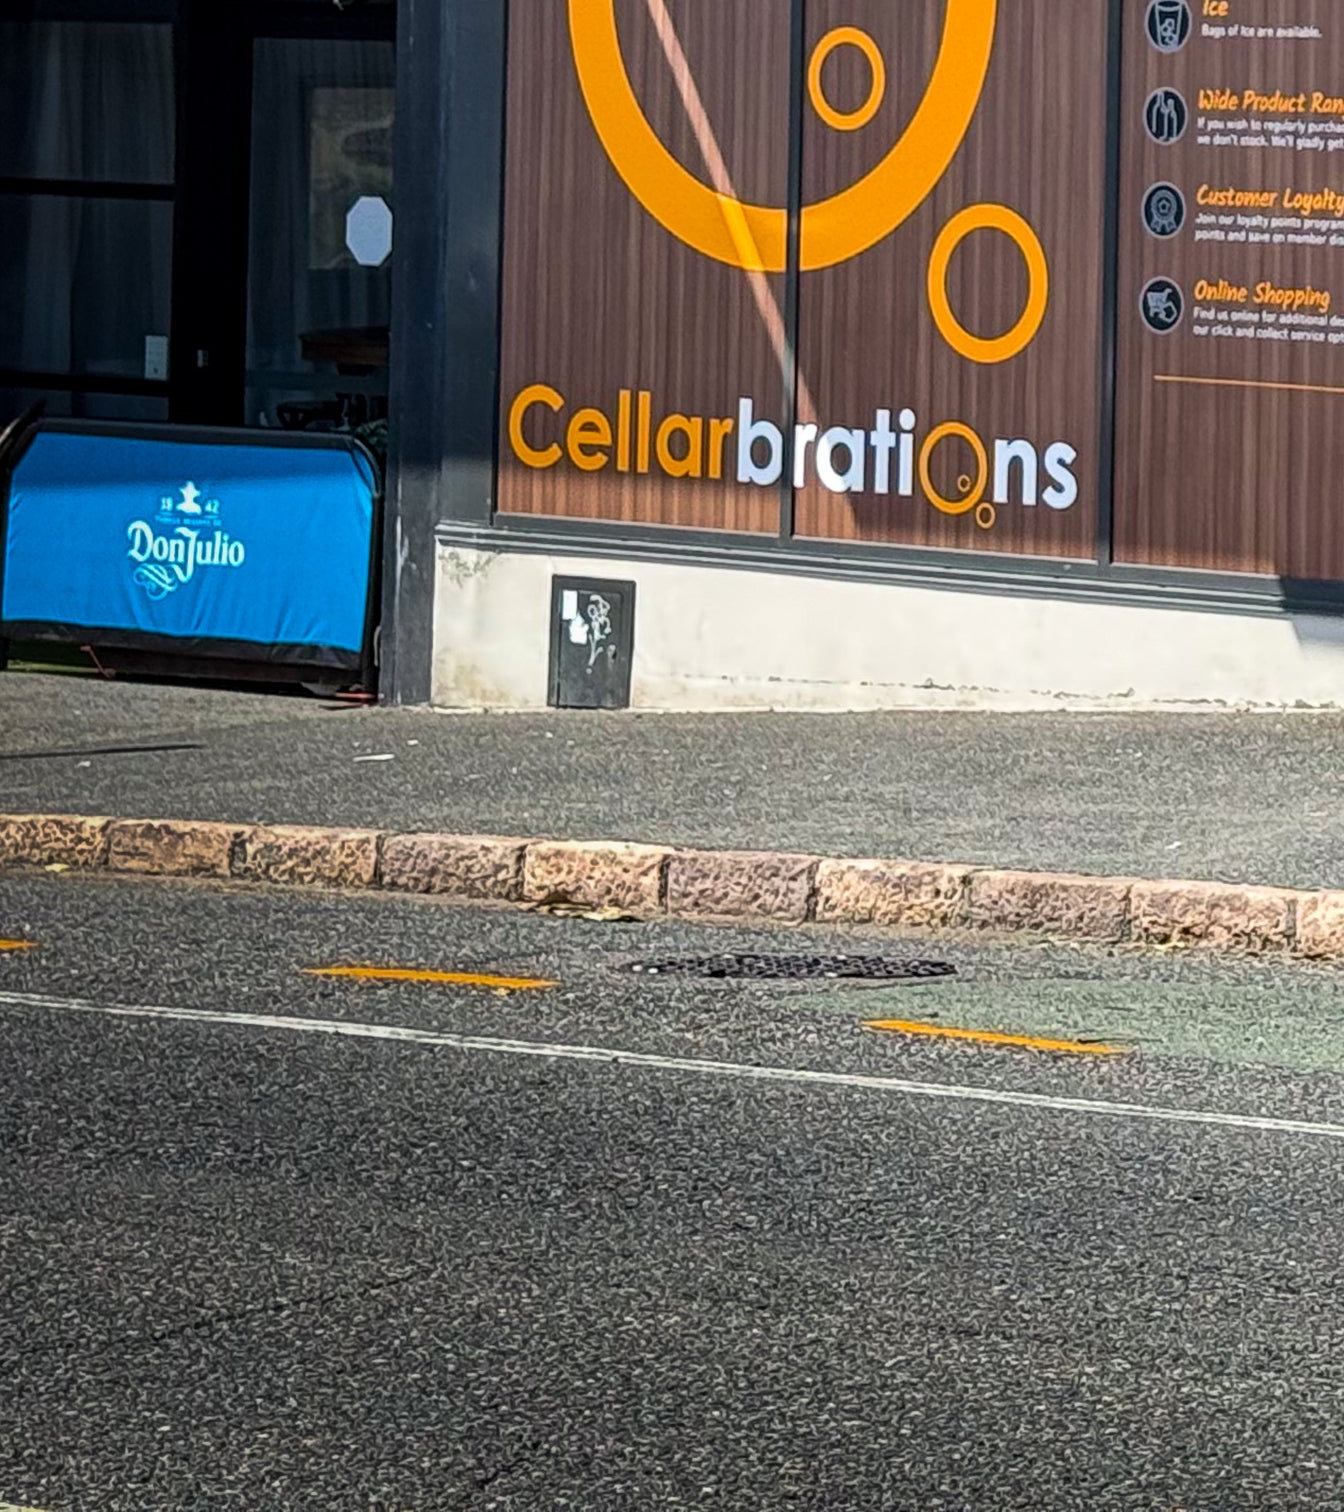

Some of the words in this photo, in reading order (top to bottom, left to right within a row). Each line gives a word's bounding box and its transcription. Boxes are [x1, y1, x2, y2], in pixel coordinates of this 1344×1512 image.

[1202, 24, 1224, 39] Bags
[1227, 24, 1239, 36] of
[1257, 26, 1273, 38] are
[1199, 89, 1238, 110] Wide
[1243, 91, 1305, 112] Product
[1207, 119, 1223, 131] you
[1226, 119, 1248, 130] wish
[1251, 120, 1261, 130] to
[1264, 119, 1306, 134] regularly
[1297, 136, 1325, 150] gladly
[1328, 138, 1343, 151] get
[1197, 185, 1275, 209] Customer
[1196, 215, 1218, 227] Join
[1220, 216, 1235, 227] our
[1238, 215, 1268, 229] loyalty
[1271, 216, 1301, 231] points
[1195, 230, 1224, 244] points
[1228, 230, 1245, 242] and
[1249, 233, 1270, 243] save
[1273, 233, 1285, 244] on
[1288, 233, 1327, 246] member
[1195, 281, 1247, 302] Online
[1254, 282, 1330, 312] Shopping
[1194, 308, 1214, 320] Find
[1218, 310, 1229, 320] us
[1231, 309, 1259, 322] online
[1262, 310, 1276, 322] for
[1279, 310, 1327, 326] additional
[1213, 324, 1235, 337] click
[1238, 326, 1254, 338] and
[1257, 326, 1288, 339] collect
[1291, 328, 1325, 341] service
[509, 384, 1078, 516] Cellarbrations
[127, 520, 185, 562] Don
[174, 527, 245, 583] Julio
